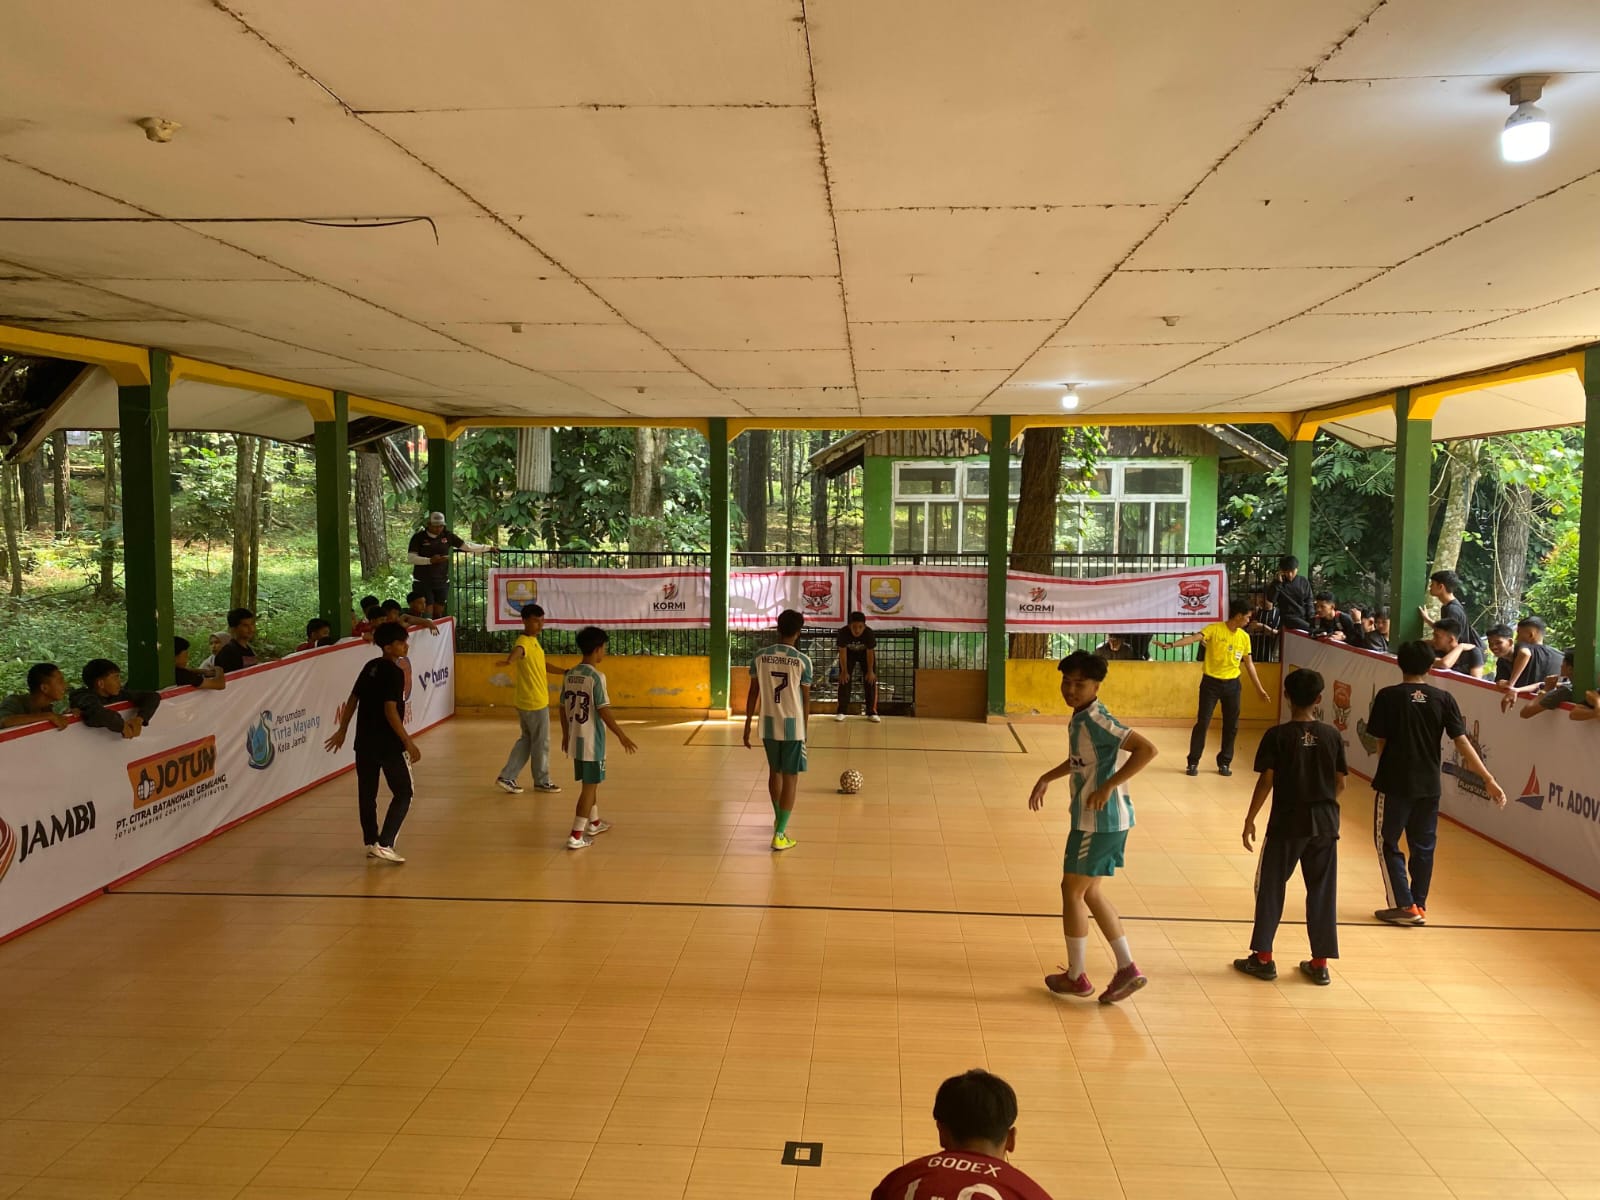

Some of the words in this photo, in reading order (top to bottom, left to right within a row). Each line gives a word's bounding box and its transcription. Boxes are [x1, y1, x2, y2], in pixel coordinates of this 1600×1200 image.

[653, 602, 686, 610] KORMI
[1019, 604, 1055, 612] KORMI
[771, 671, 788, 703] 7
[276, 708, 306, 725] Perumdam
[272, 726, 291, 741] Tirta
[293, 716, 320, 734] Mayang
[277, 742, 290, 753] Kota
[292, 735, 306, 749] Jambi
[156, 744, 216, 794] JOTUN
[116, 818, 128, 830] PT.
[129, 809, 152, 825] CITRA
[152, 790, 195, 815] BATANGHARI
[196, 774, 227, 794] GEMILANG
[1548, 782, 1564, 808] PT.
[19, 800, 96, 863] JAMBI
[114, 826, 137, 840] JOTUN
[927, 1156, 1002, 1178] GODEX
